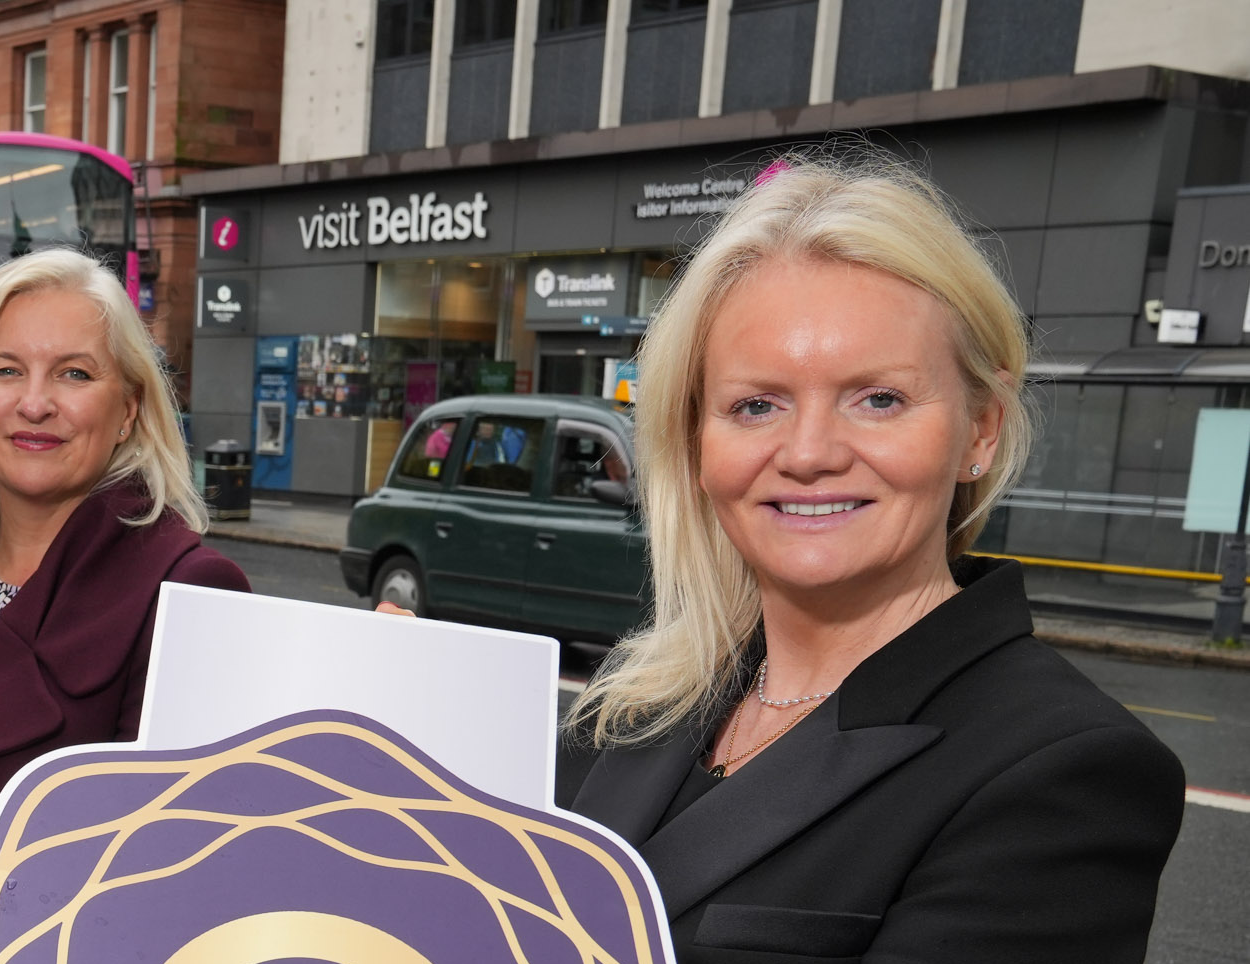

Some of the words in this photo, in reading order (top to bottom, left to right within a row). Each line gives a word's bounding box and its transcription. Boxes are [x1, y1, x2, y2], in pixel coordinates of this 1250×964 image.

[643, 182, 700, 199] Welcome
[701, 179, 746, 195] Centre
[298, 202, 361, 249] visit
[367, 192, 488, 245] Belfast
[556, 273, 615, 293] Translink
